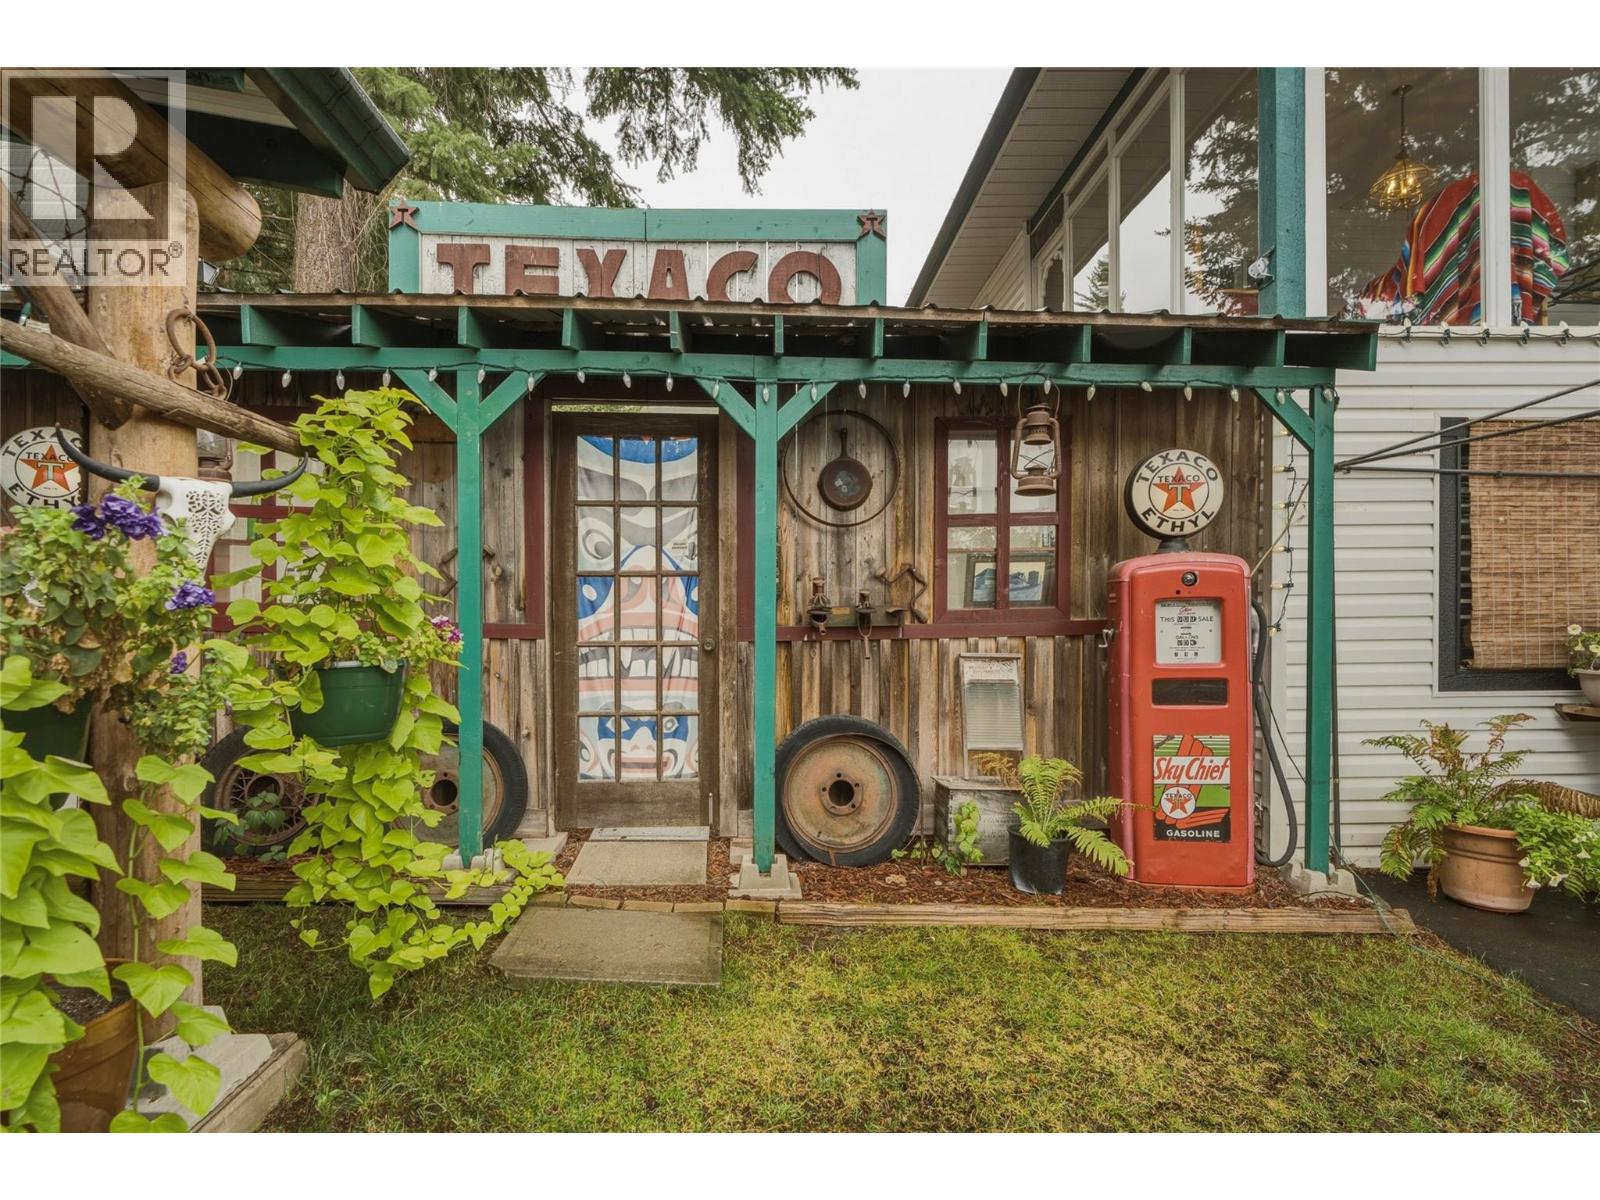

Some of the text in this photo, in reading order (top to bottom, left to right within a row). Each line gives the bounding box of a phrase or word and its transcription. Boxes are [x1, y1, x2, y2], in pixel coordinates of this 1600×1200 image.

[1136, 451, 1218, 483] TEXACO
[1158, 474, 1200, 483] TEXACO
[1141, 507, 1214, 532] ETHYL
[1154, 757, 1230, 784] Sky Chief
[1166, 829, 1220, 838] GASOLINE
